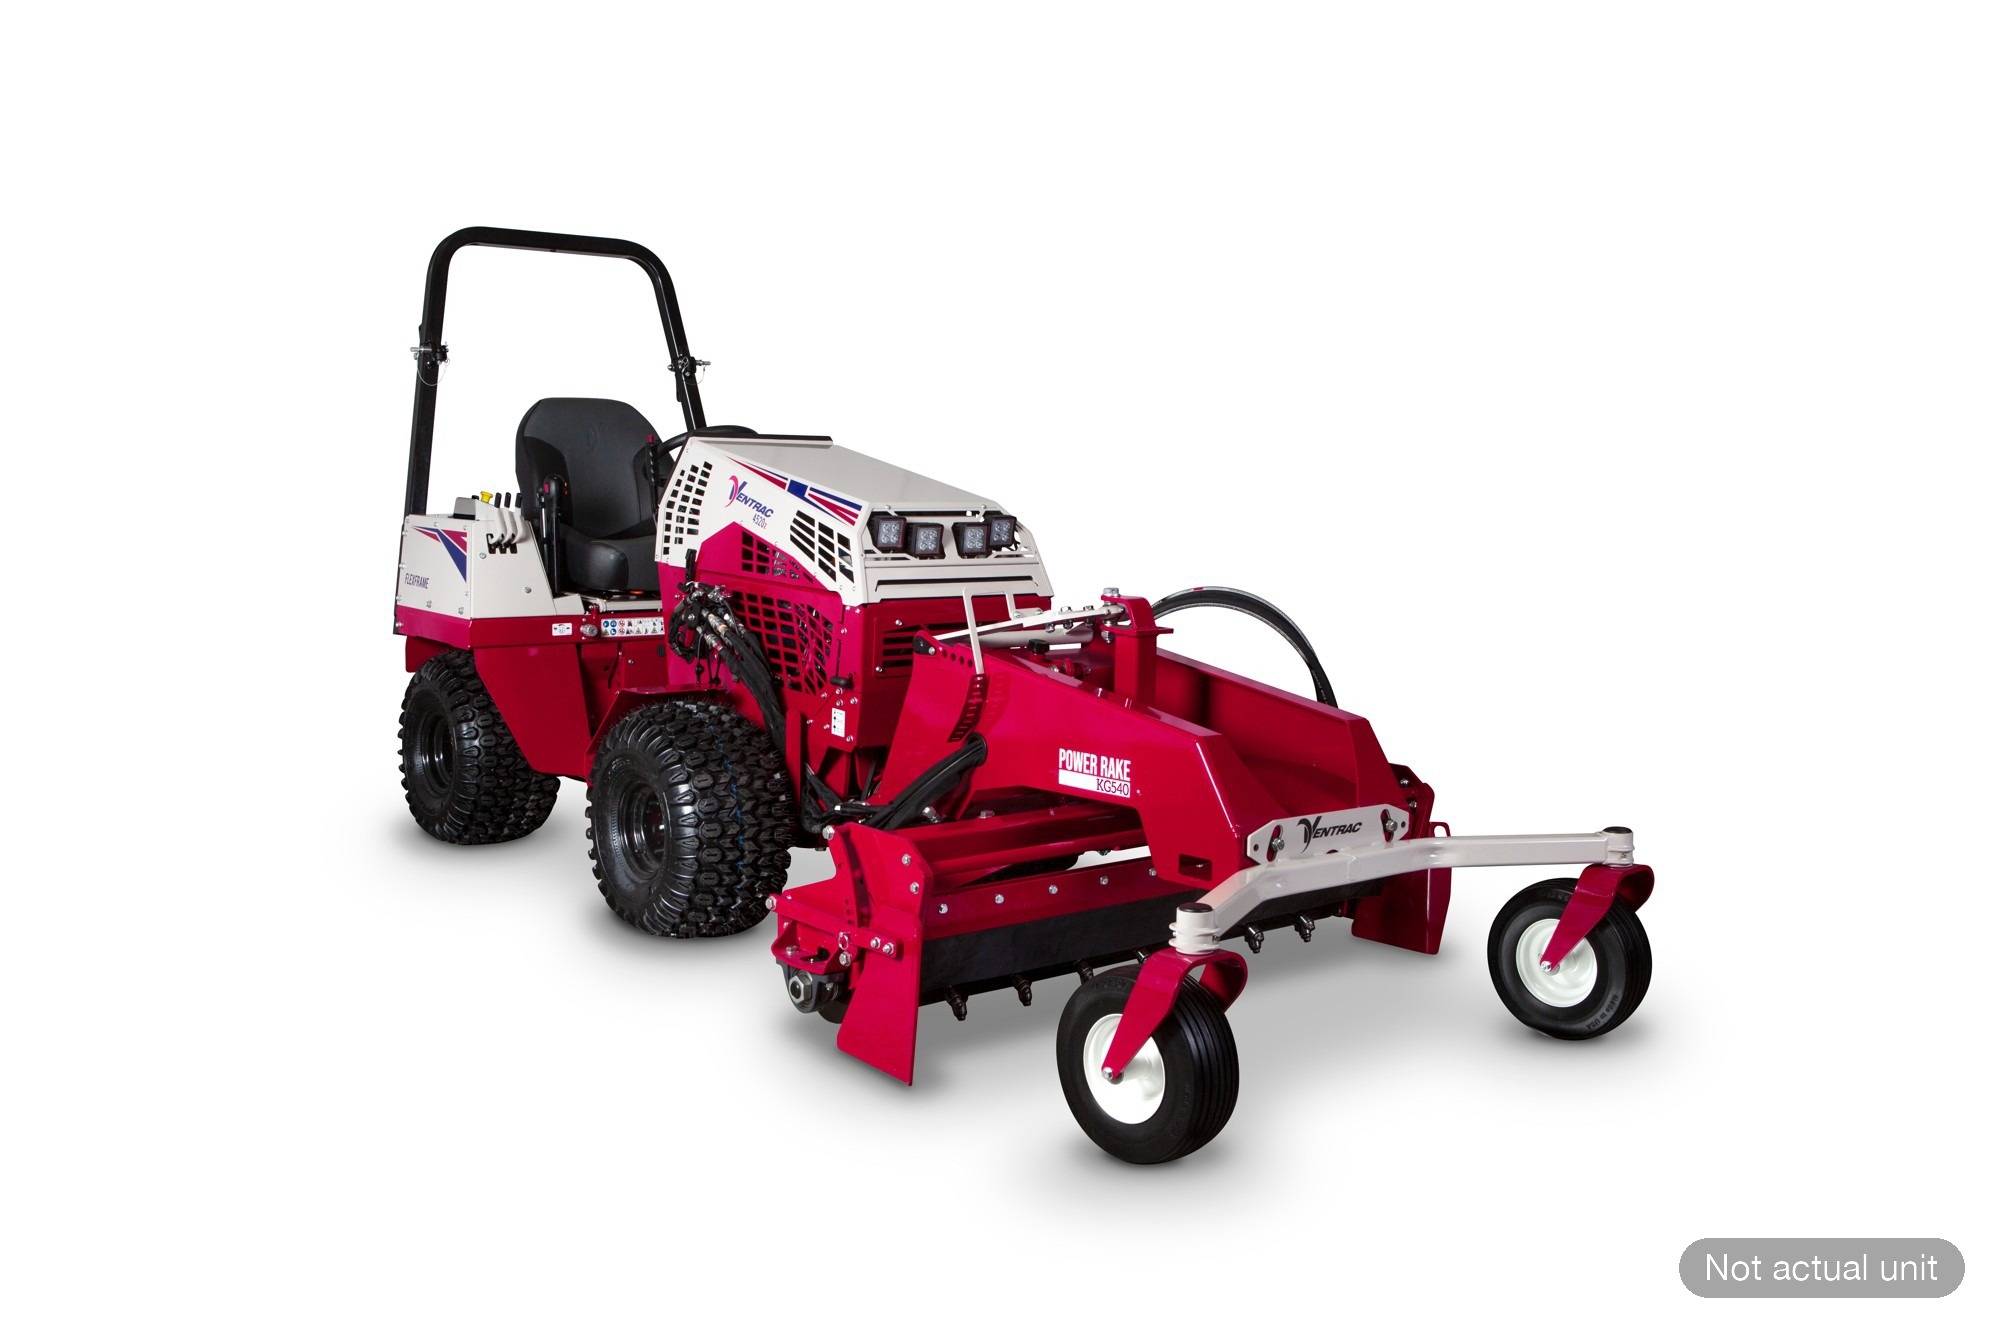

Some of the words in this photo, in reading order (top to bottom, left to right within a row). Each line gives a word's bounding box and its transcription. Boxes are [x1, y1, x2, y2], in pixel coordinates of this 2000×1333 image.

[725, 475, 774, 518] VENTRAC
[404, 572, 430, 590] FLEXFRAME
[1059, 748, 1098, 775] POWER
[1100, 755, 1131, 781] RAKE
[1097, 778, 1130, 796] KG540
[1297, 816, 1363, 854] VENTRAC
